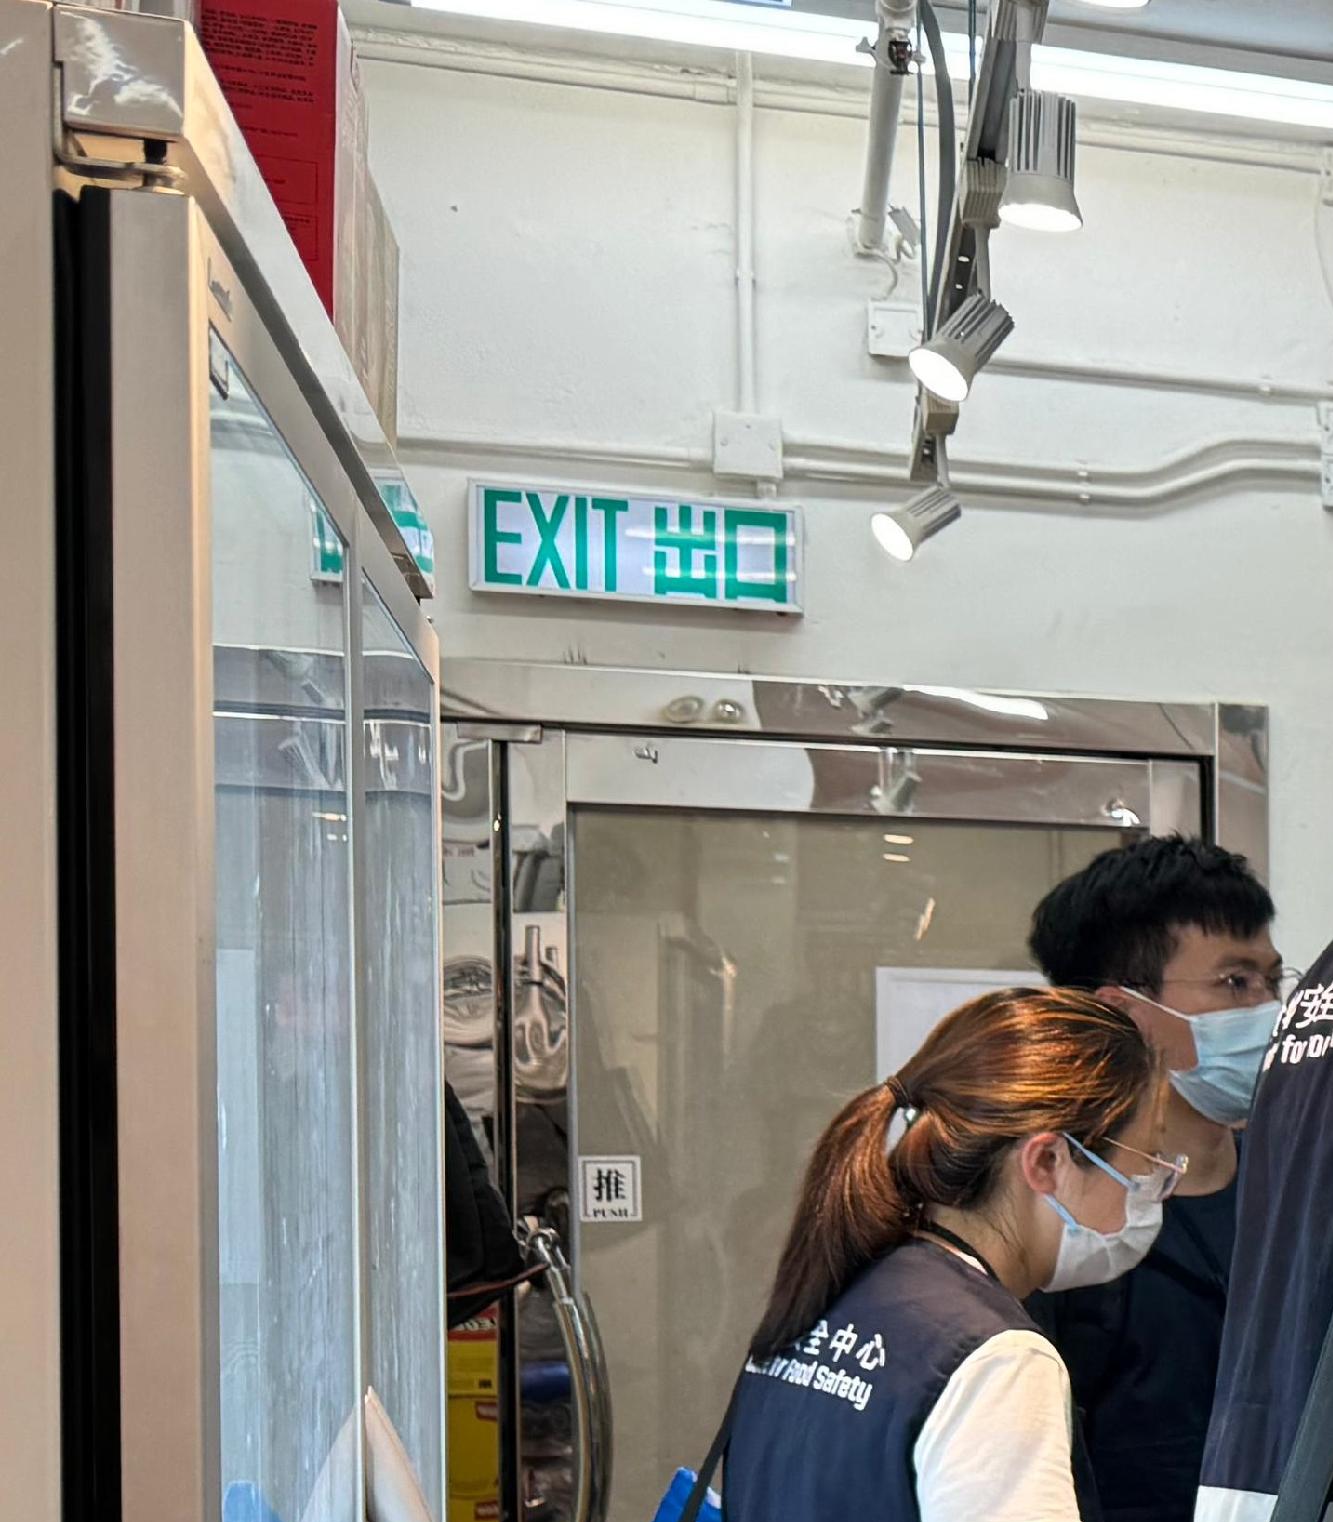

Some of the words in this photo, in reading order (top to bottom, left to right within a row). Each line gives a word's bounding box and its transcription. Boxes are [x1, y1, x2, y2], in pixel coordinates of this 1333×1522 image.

[484, 489, 628, 592] EXIT
[654, 501, 788, 604] 出口
[593, 1169, 626, 1202] 推
[813, 1361, 872, 1411] Safety
